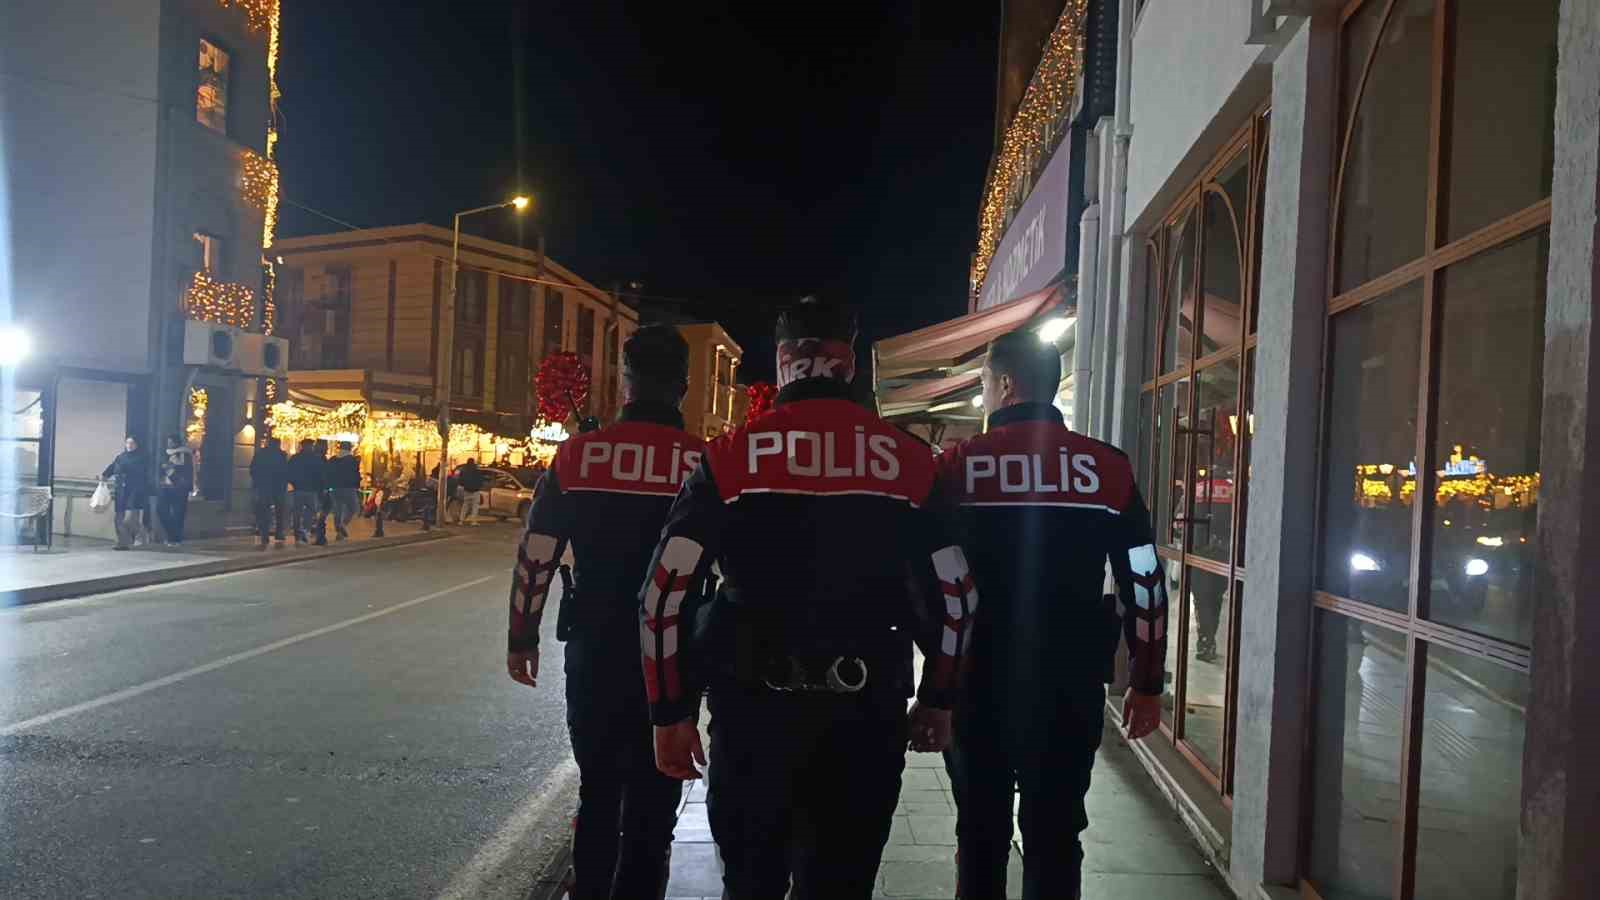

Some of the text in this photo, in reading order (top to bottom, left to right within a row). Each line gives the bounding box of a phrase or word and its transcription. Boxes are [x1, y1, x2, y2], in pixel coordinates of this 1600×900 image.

[580, 441, 702, 484] POLİS
[748, 425, 900, 481] POLİS
[965, 447, 1100, 494] POLİS
